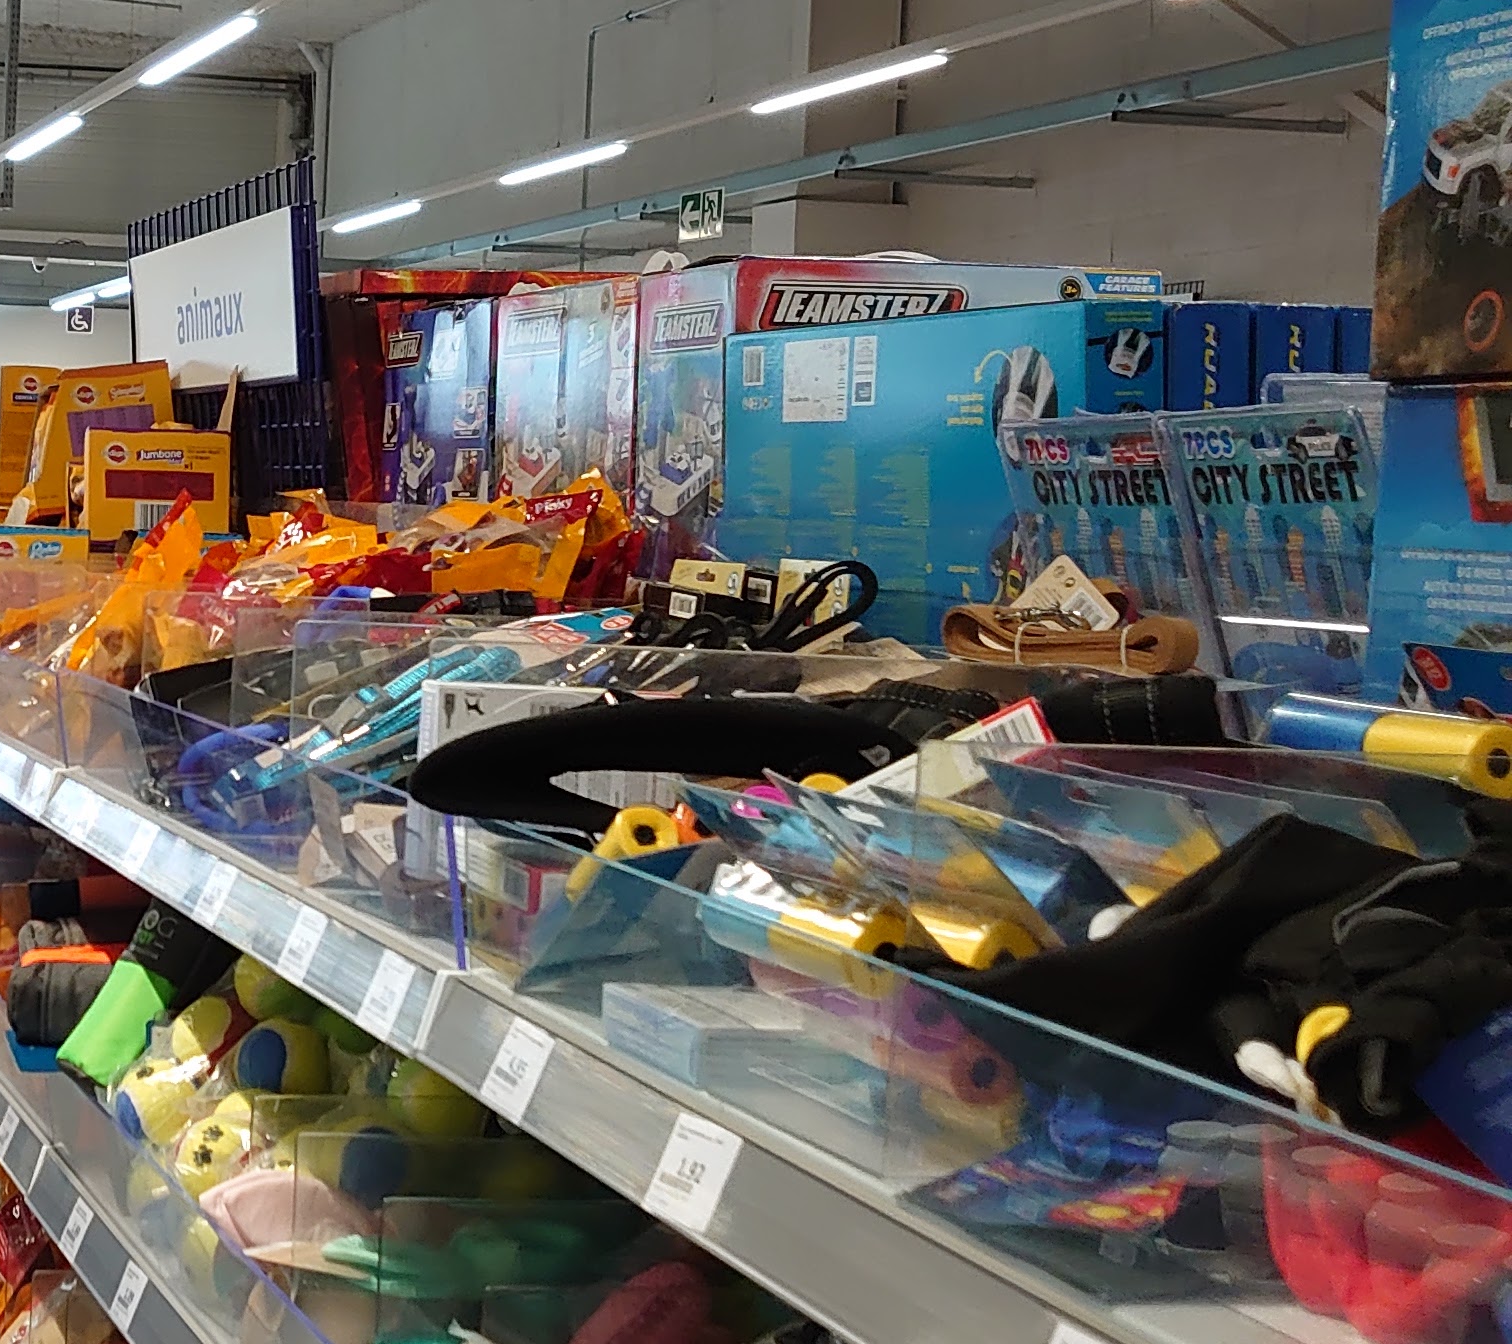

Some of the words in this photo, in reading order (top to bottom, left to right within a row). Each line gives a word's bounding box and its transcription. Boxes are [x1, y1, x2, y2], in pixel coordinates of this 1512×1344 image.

[177, 286, 244, 345] animaux
[654, 306, 718, 344] TEAMSTERZ
[140, 449, 182, 460] Jumbone
[1033, 469, 1082, 505] CITY
[1090, 467, 1172, 505] STREET
[1192, 464, 1249, 505] CITY
[1259, 460, 1358, 504] STREET
